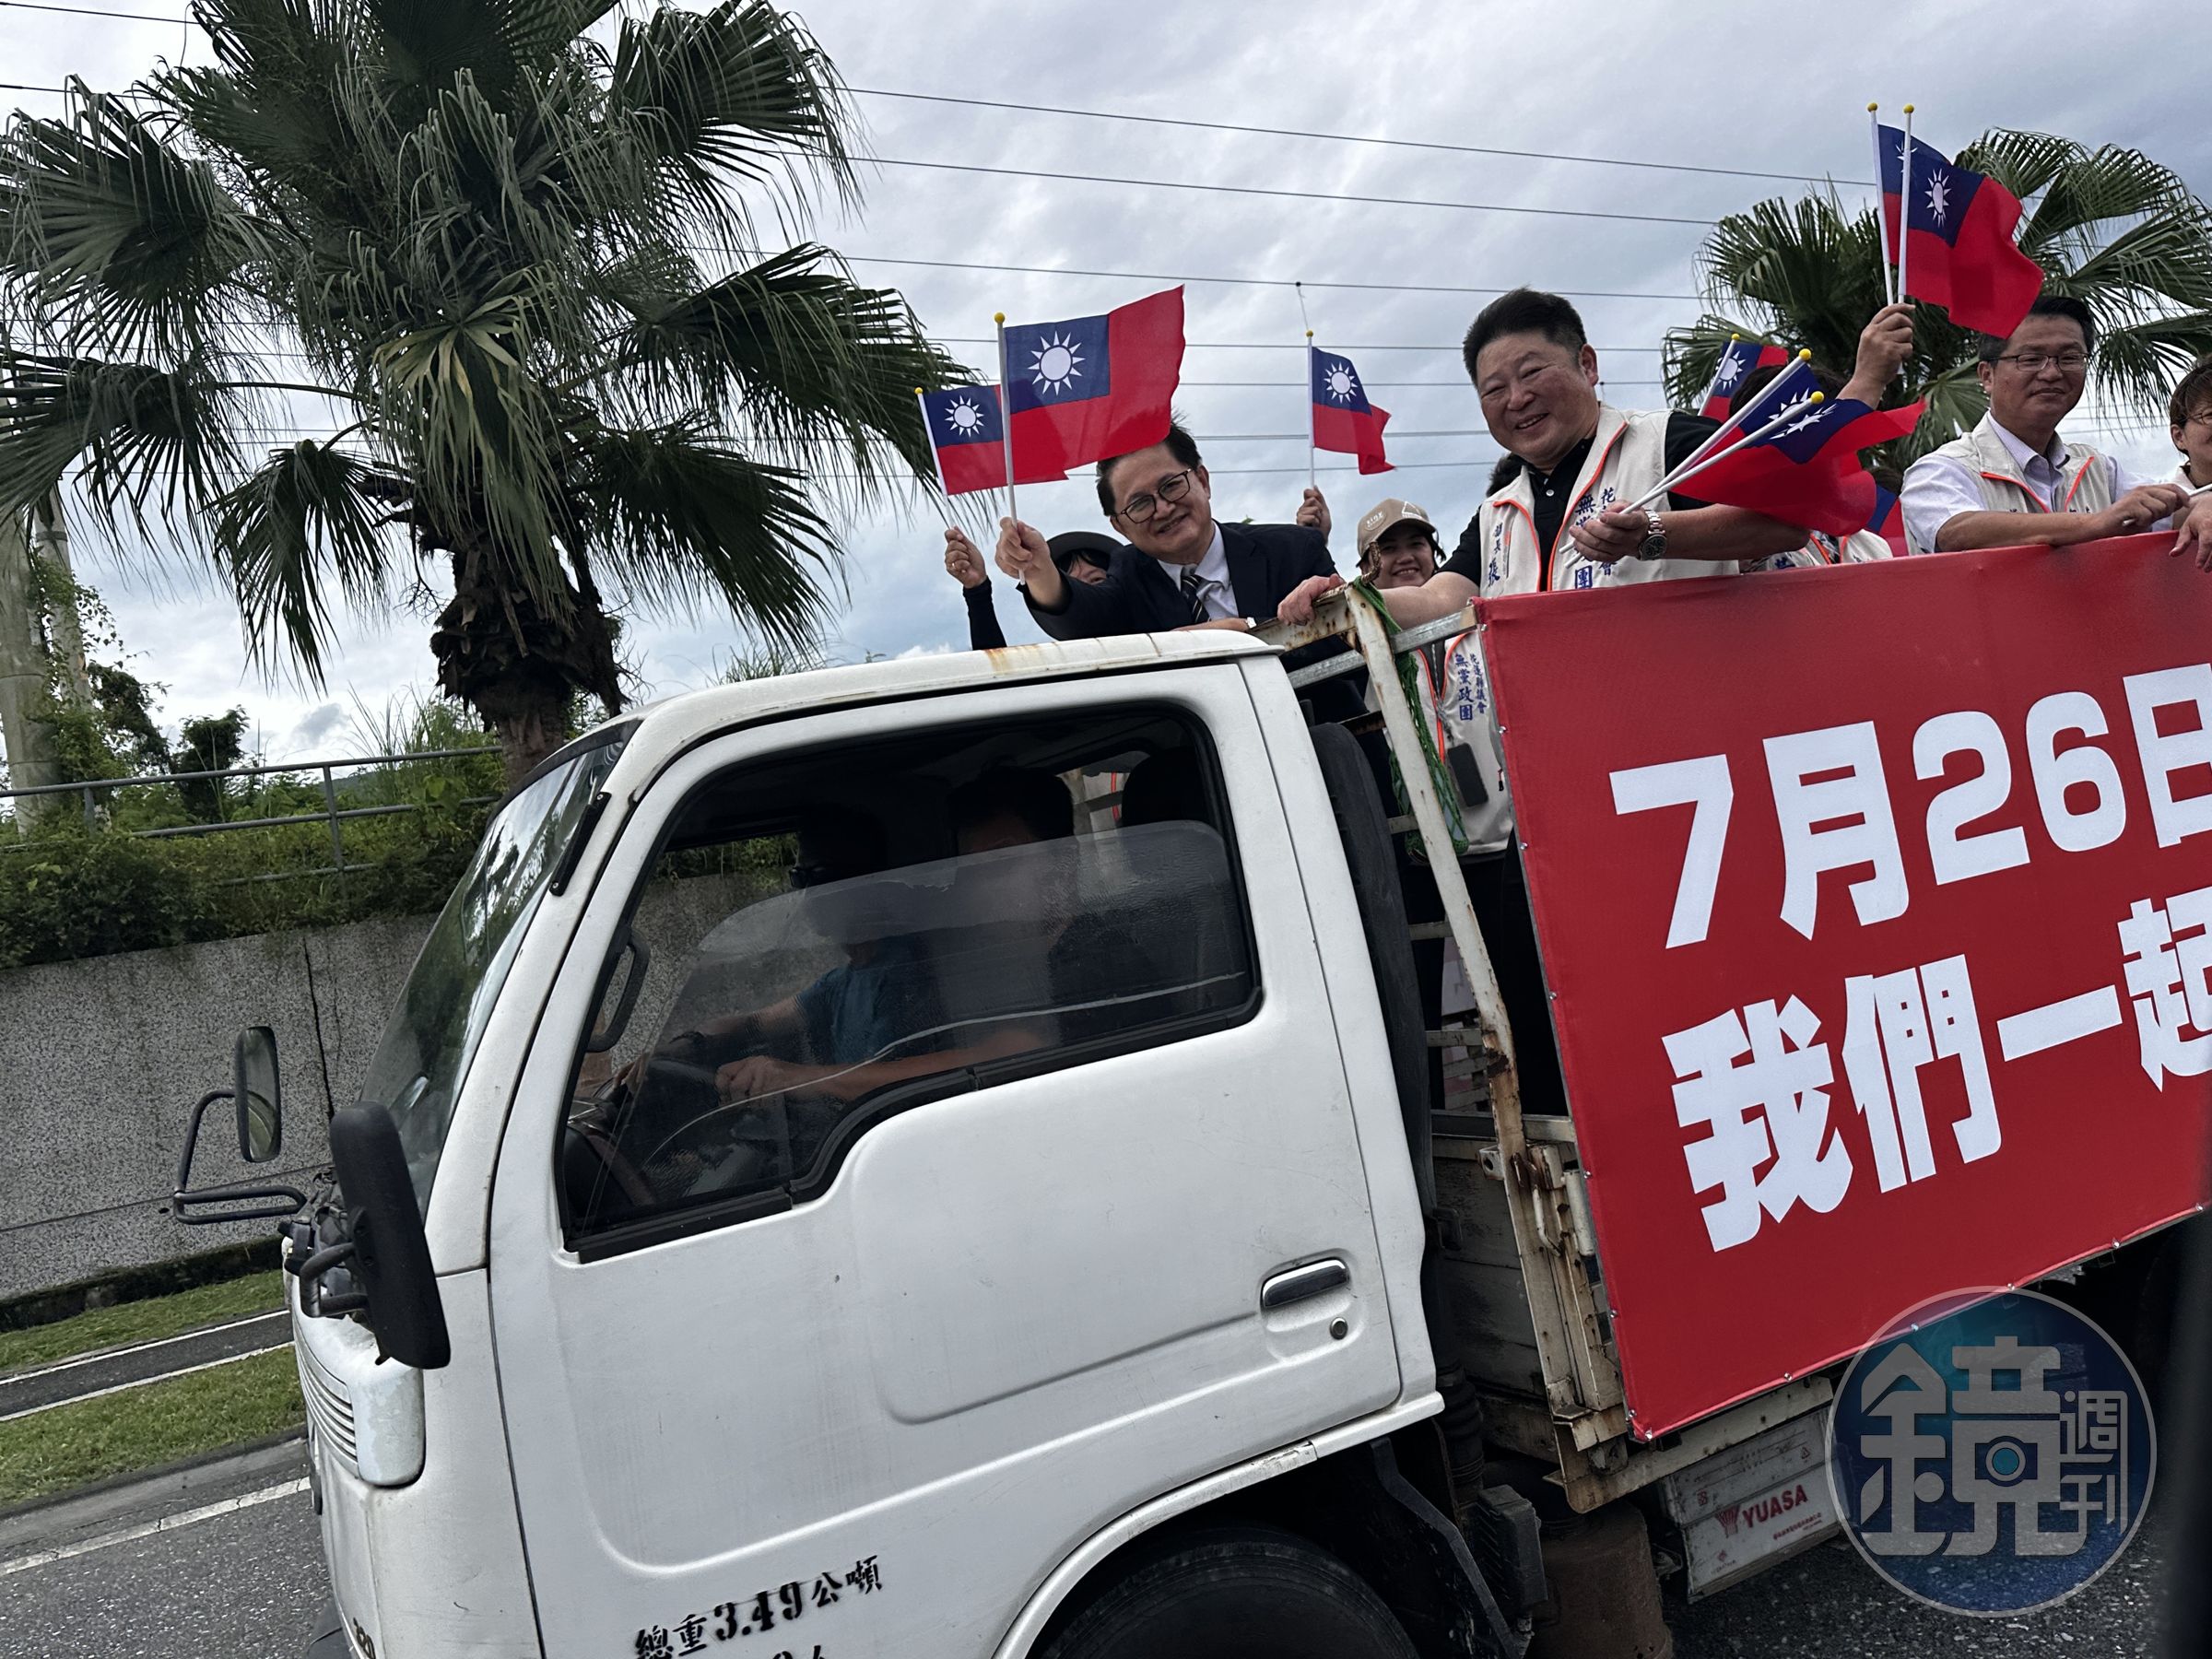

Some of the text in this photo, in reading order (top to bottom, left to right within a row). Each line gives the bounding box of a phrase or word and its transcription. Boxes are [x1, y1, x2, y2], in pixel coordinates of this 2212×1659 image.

[1575, 494, 1595, 589] 無團
[1454, 653, 1475, 721] 無黨政團
[1609, 663, 2212, 949] 7月26日
[1662, 886, 2212, 1252] 我們一起
[1741, 1484, 1808, 1528] YUASA
